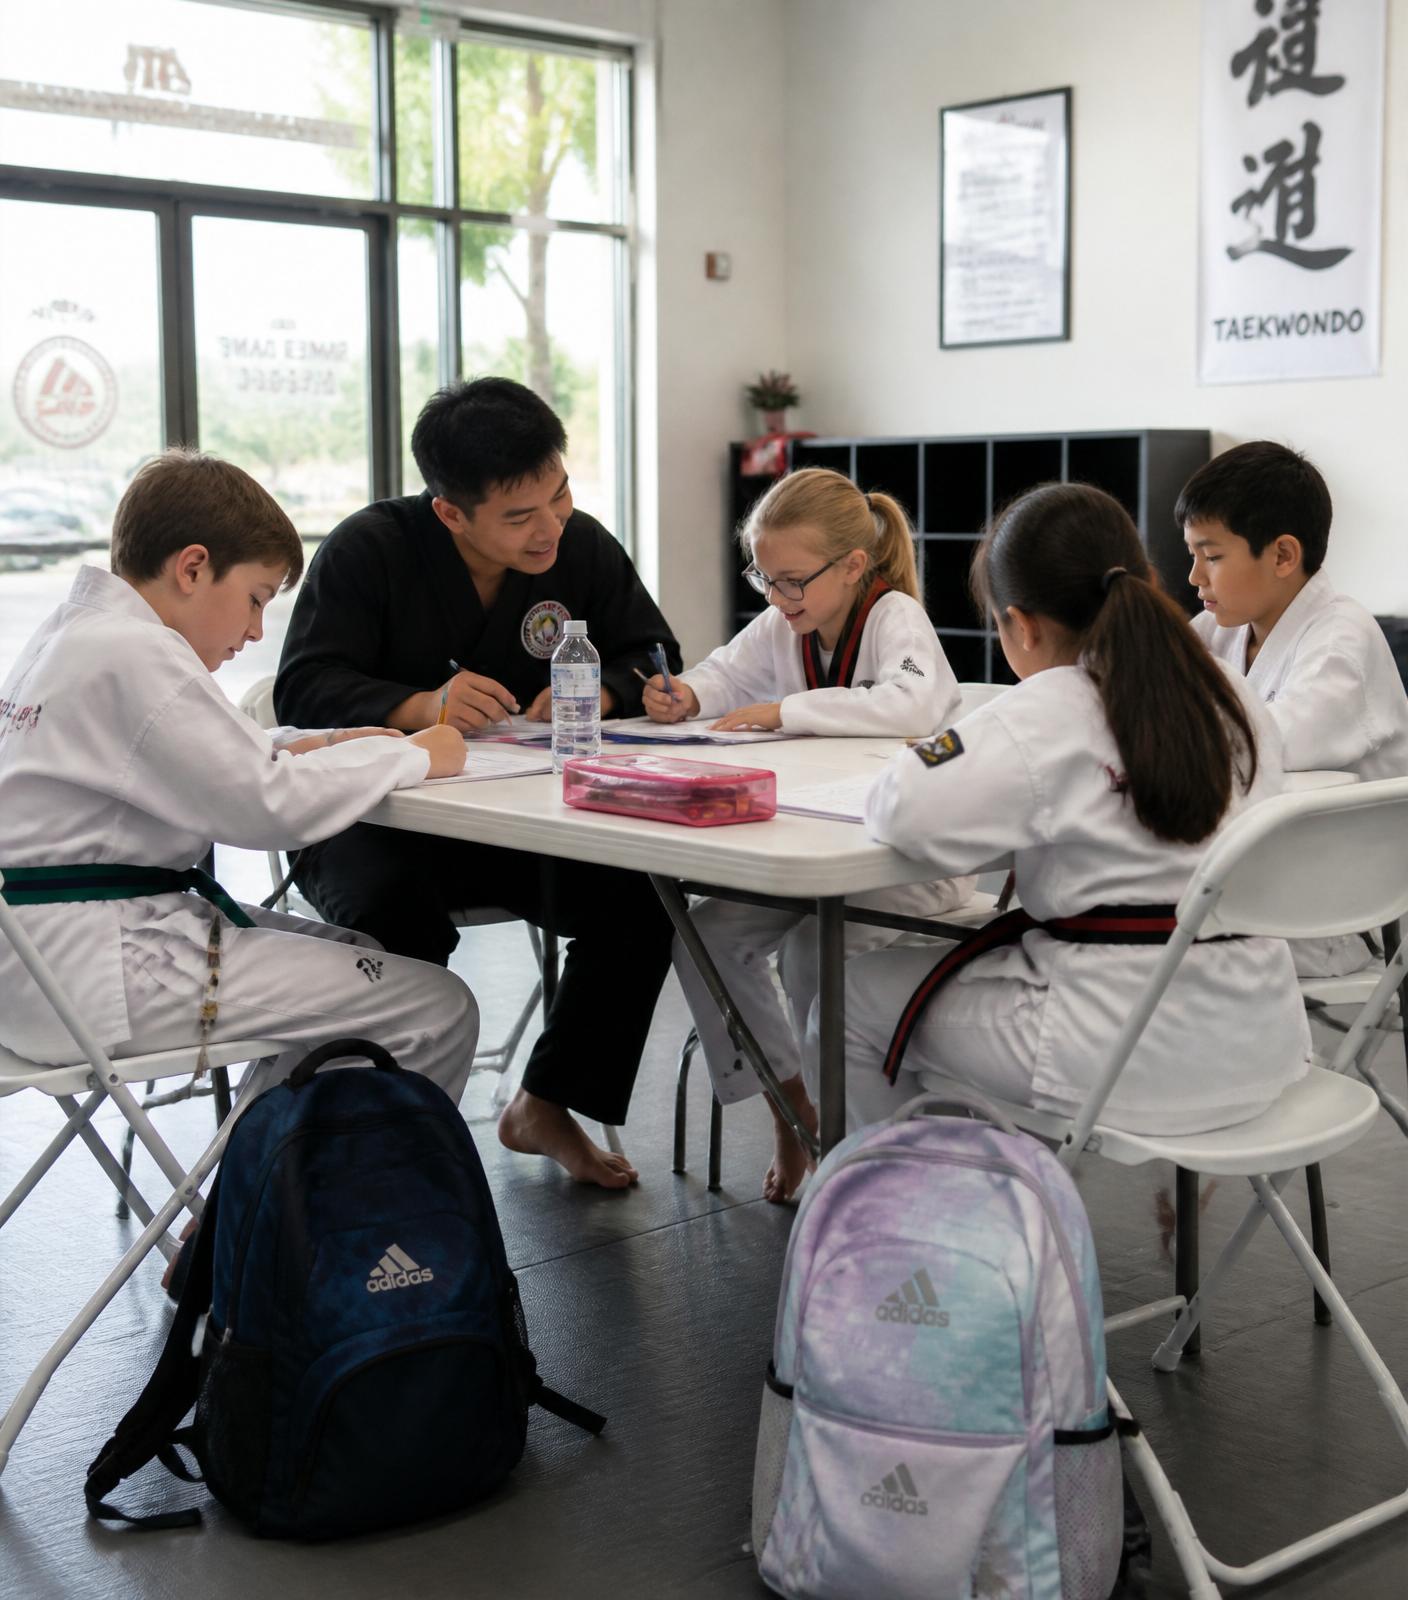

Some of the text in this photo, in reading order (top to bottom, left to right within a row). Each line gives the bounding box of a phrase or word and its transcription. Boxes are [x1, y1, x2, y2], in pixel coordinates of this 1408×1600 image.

[1214, 308, 1364, 341] TAEKWONDO
[366, 1267, 434, 1293] adidas
[875, 1301, 950, 1328] adidas
[860, 1490, 929, 1516] adidas
